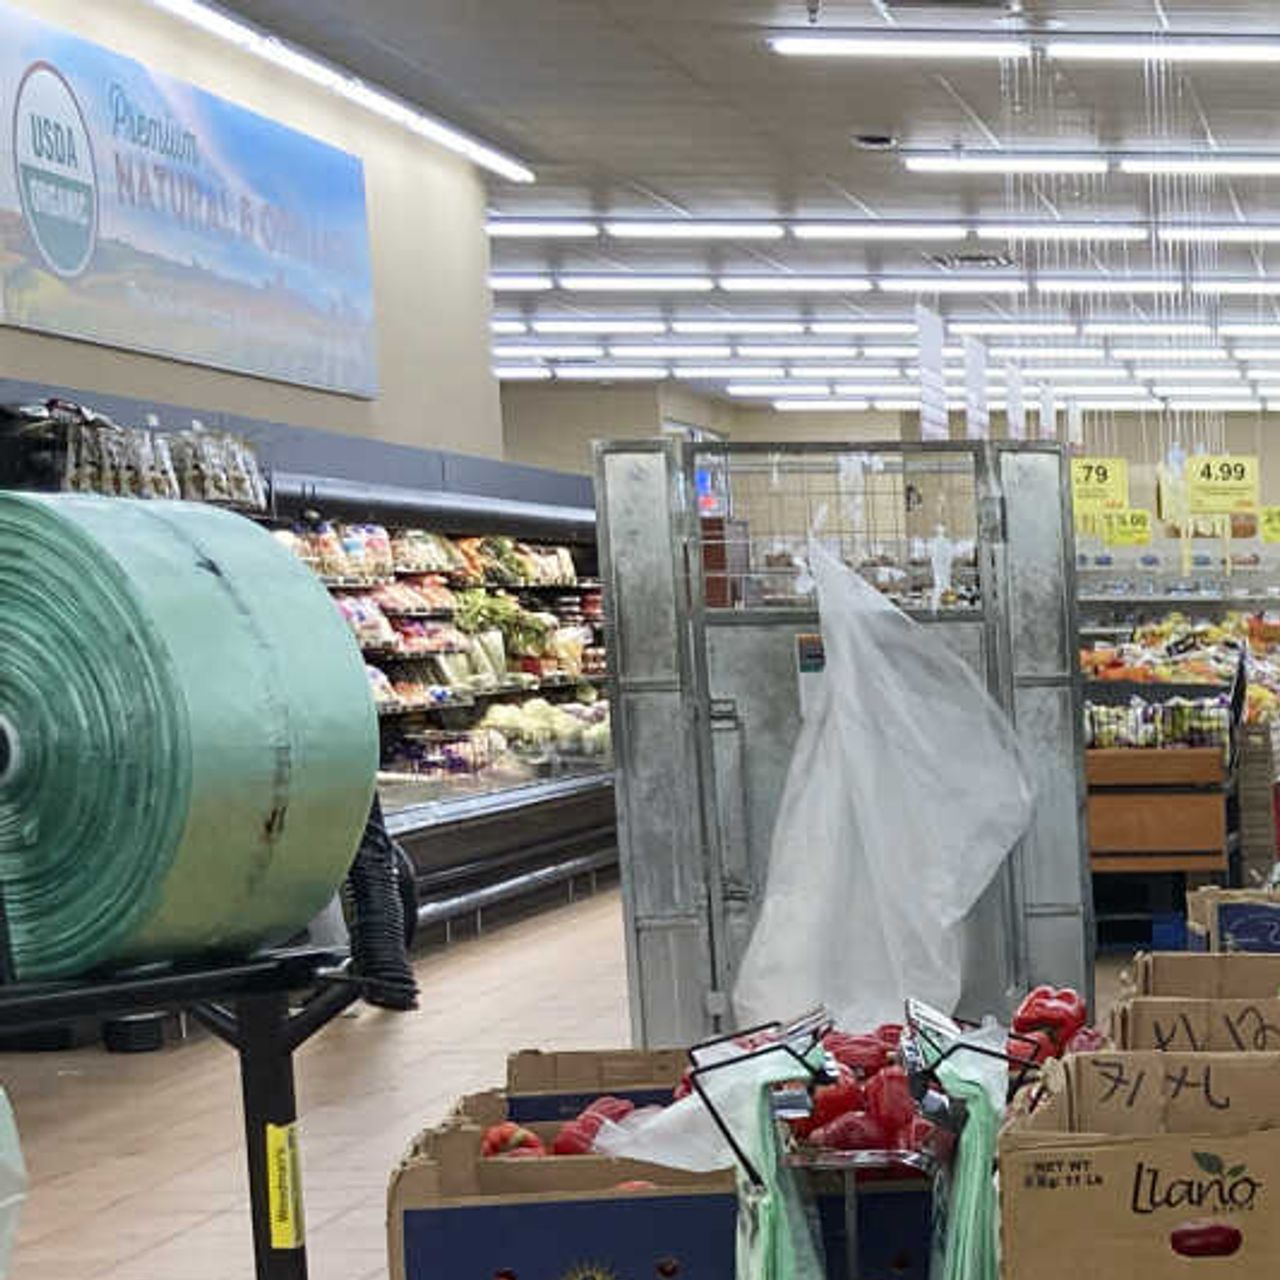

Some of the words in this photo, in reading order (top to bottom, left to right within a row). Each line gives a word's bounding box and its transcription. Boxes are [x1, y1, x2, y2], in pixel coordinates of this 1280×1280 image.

[30, 114, 78, 168] USDA
[108, 82, 200, 166] Premium
[1200, 462, 1246, 482] 4.99
